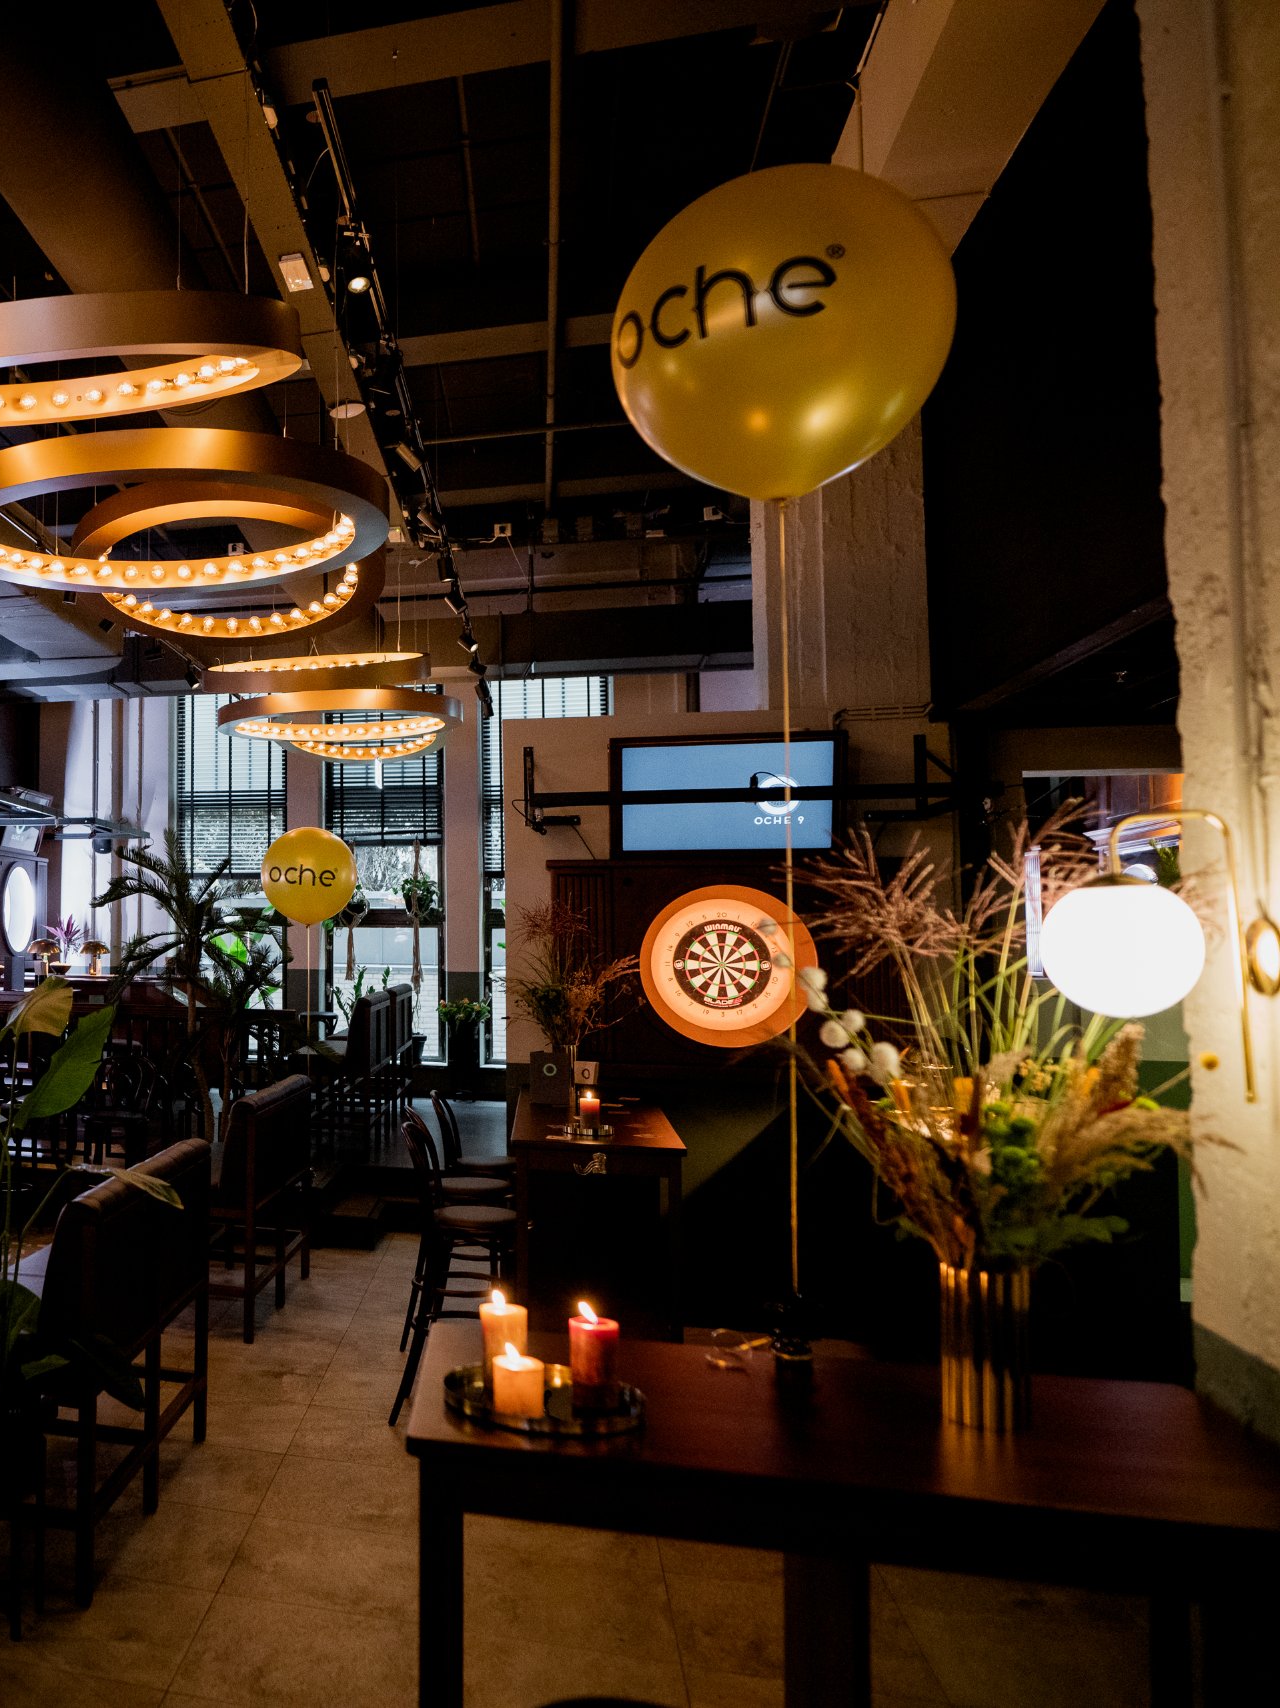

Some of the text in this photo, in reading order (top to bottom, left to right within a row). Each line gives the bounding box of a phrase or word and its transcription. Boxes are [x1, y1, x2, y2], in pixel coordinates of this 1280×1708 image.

[753, 815, 805, 825] OCHE 9
[704, 923, 741, 932] WINMAU
